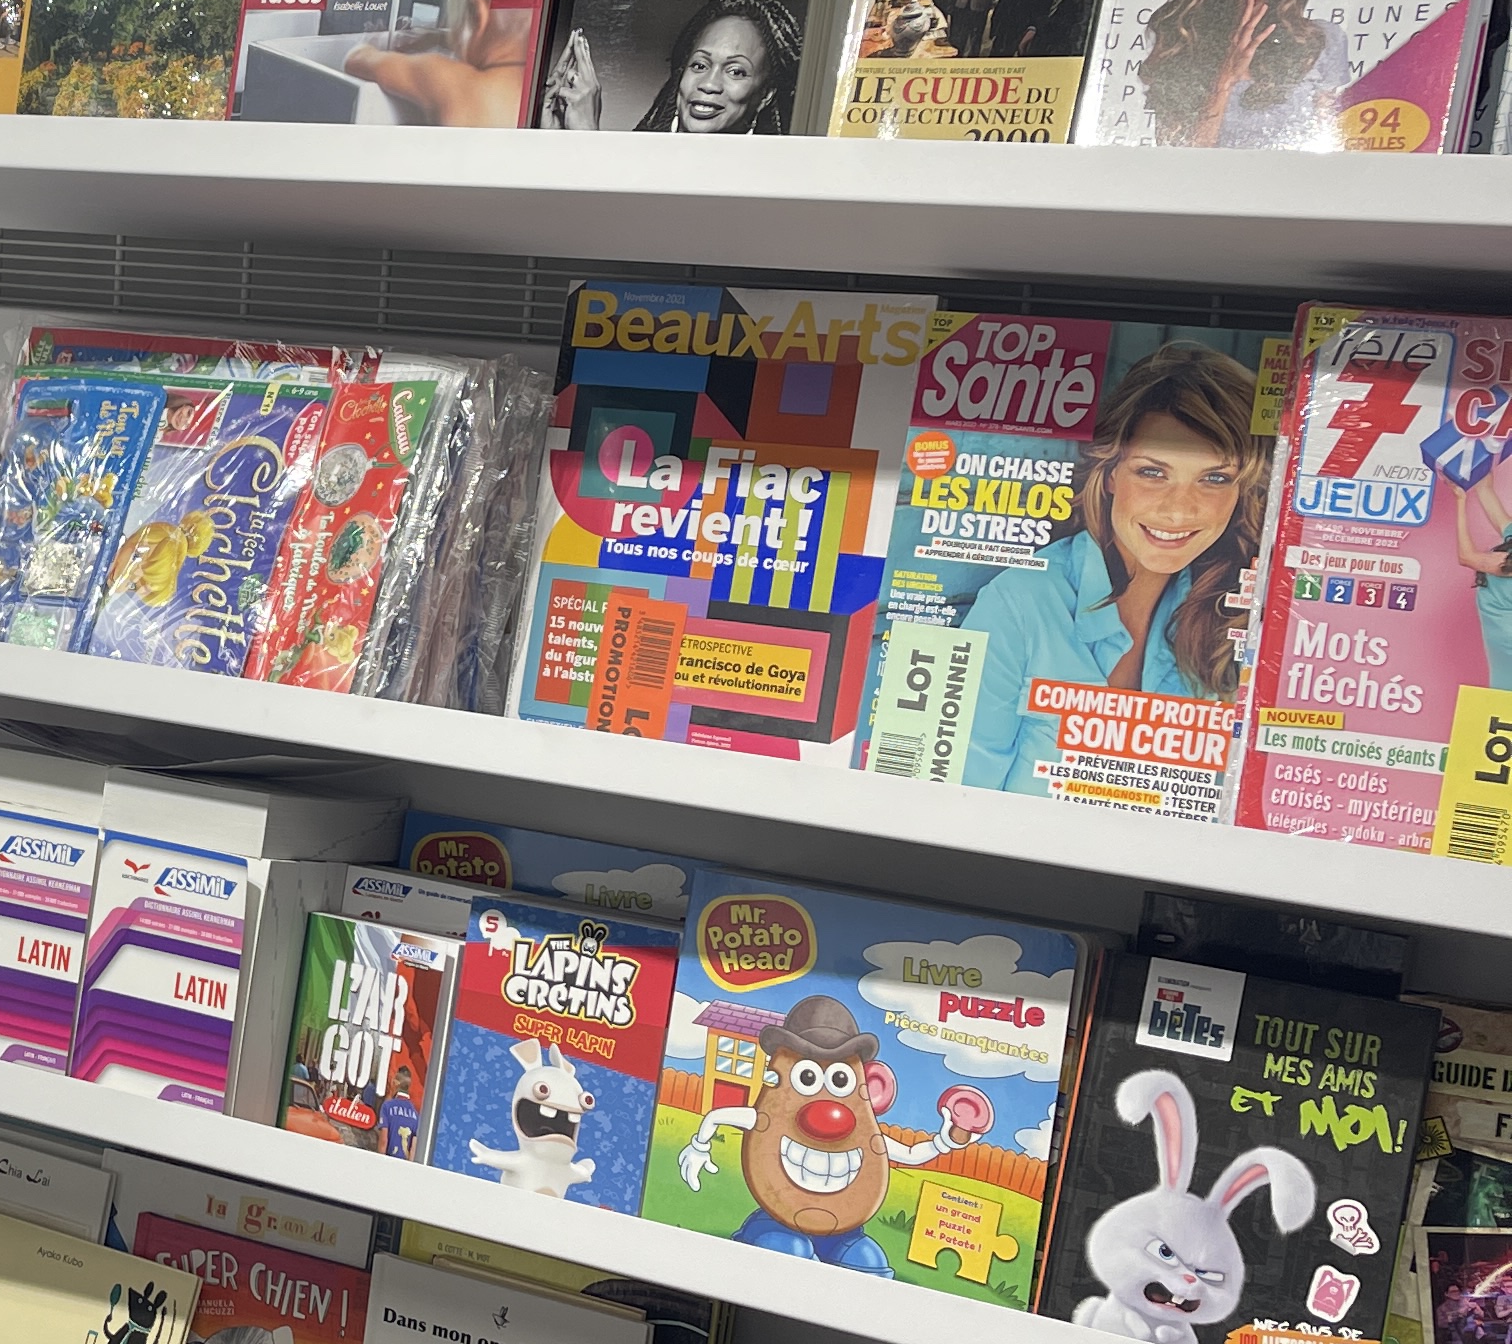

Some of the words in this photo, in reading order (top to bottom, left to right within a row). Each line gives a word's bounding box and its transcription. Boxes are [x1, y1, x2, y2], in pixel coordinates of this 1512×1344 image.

[852, 76, 896, 103] LE
[902, 76, 1023, 104] GUIDE
[1024, 87, 1060, 104] DU
[847, 108, 1054, 125] COLLECTIONNEUR
[1359, 107, 1401, 134] 94
[975, 321, 1057, 361] TOP
[921, 339, 1096, 429] Santé
[616, 439, 683, 492] La
[701, 446, 824, 503] Fiac
[955, 453, 993, 477] ON
[996, 455, 1075, 485] CHASSE
[1373, 464, 1429, 481] INEDITS
[911, 476, 970, 511] LES
[973, 478, 1075, 521] KILOS
[1299, 479, 1426, 521] JEUX
[921, 511, 958, 536] DU
[960, 514, 1052, 546] STRESS
[605, 537, 644, 557] Tous
[647, 543, 678, 561] nos
[681, 548, 734, 568] coups
[737, 554, 759, 569] de
[762, 558, 810, 574] cœur
[1301, 550, 1322, 566] Des
[1324, 552, 1347, 570] jeux
[1350, 558, 1376, 574] pour
[1381, 561, 1403, 574] tous
[1292, 620, 1389, 667] Mots
[745, 661, 764, 676] de
[768, 664, 806, 683] Goya
[1287, 664, 1425, 715] fléchés
[1267, 711, 1336, 725] NOUVEAU
[1264, 727, 1287, 747] Les
[1292, 734, 1326, 753] mots
[1332, 739, 1383, 759] croisés
[1386, 746, 1435, 767] géants
[1077, 755, 1136, 773] PRÉVENIR
[1138, 765, 1158, 776] LES
[1160, 767, 1212, 784] RISQUES
[1275, 763, 1322, 785] casés
[1338, 771, 1388, 794] codés
[1066, 782, 1161, 805] AUTODIAGNOSTIC
[730, 904, 768, 926] Mr.
[707, 925, 803, 950] Potato
[17, 935, 72, 973] LATIN
[718, 948, 793, 974] Head
[902, 956, 983, 989] Livre
[173, 971, 228, 1011] LATIN
[938, 990, 1046, 1029] puzzle
[513, 1014, 562, 1045] SUPER
[566, 1023, 616, 1060] LAPIN
[1254, 1013, 1319, 1048] TOUT
[1324, 1026, 1382, 1067] SUR
[321, 1023, 403, 1097] GOT
[1262, 1053, 1313, 1088] MES
[1319, 1062, 1377, 1100] AMIS
[328, 1099, 371, 1124] italien
[1230, 1085, 1283, 1117] ET
[936, 1205, 948, 1214] un
[950, 1210, 981, 1223] grand
[938, 1219, 972, 1235] puzzle
[382, 1306, 427, 1336] Dans
